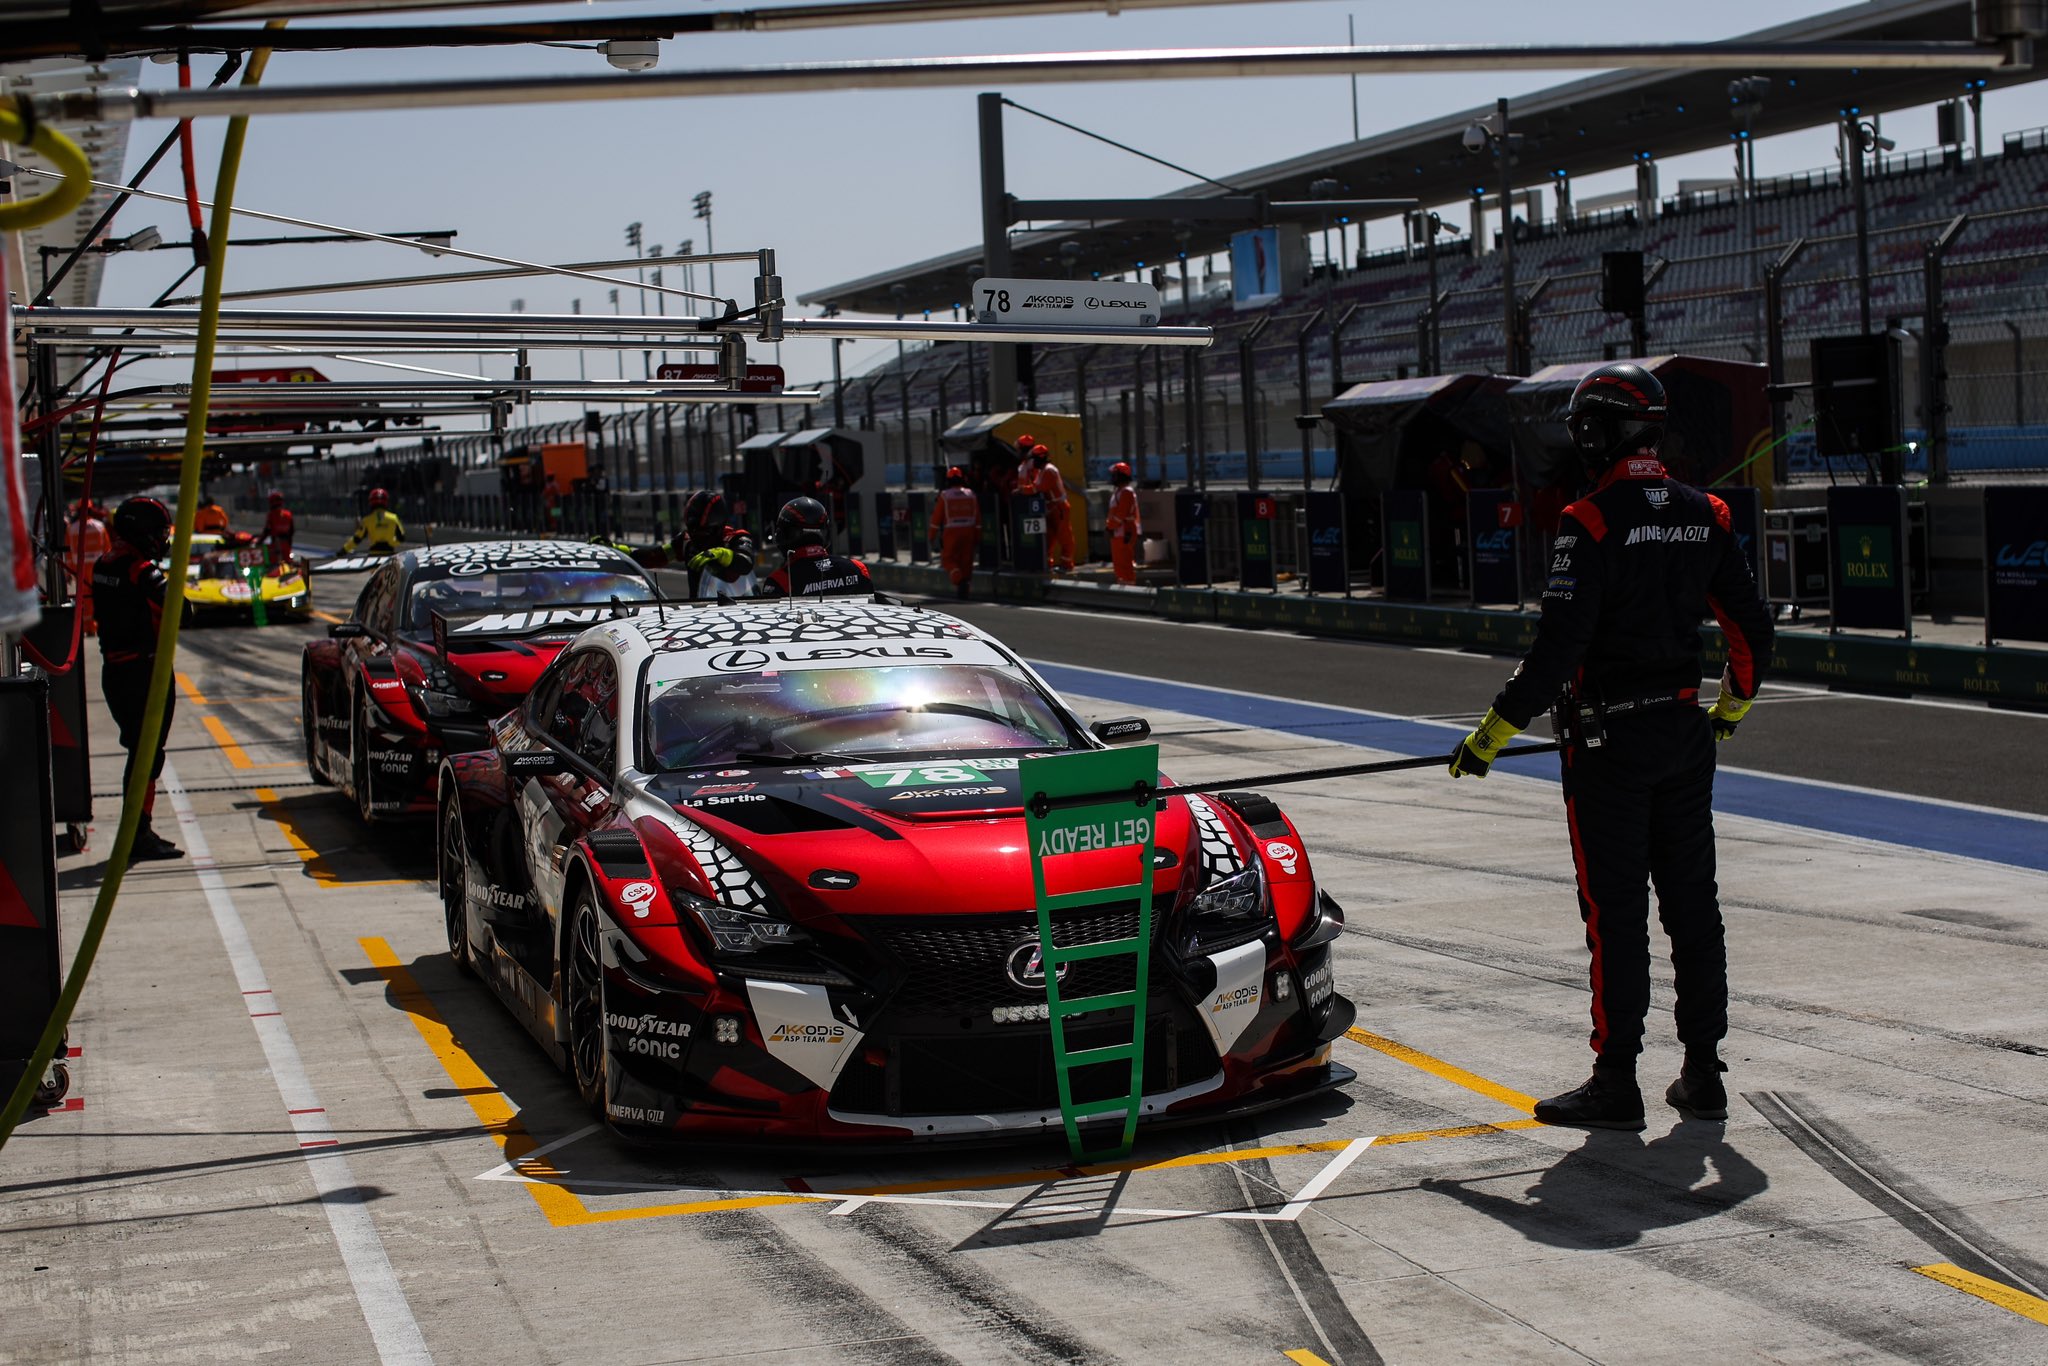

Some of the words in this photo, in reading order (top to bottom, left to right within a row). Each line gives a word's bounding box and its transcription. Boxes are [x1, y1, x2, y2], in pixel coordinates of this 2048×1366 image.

[983, 290, 1011, 313] 78
[1646, 491, 1669, 502] OMP
[1032, 501, 1040, 511] 8
[1194, 503, 1202, 516] 7
[1258, 502, 1267, 515] 8
[1502, 507, 1512, 523] 7
[1025, 520, 1041, 531] 78
[1684, 526, 1710, 542] OIL
[491, 560, 600, 570] LEXUS
[1847, 562, 1888, 578] ROLEX
[802, 578, 845, 595] MINERVA
[776, 647, 953, 661] LEXUS
[1816, 660, 1847, 676] ROLEX
[1896, 669, 1931, 686] ROLEX
[1963, 677, 2000, 693] ROLEX
[865, 767, 976, 787] 78
[707, 794, 766, 805] Sarthe
[1038, 823, 1106, 856] READY
[1111, 818, 1150, 847] GET
[467, 881, 525, 910] GOODYEAR
[628, 885, 648, 897] CSC
[1222, 1000, 1233, 1010] ASP
[1233, 999, 1248, 1007] TEAM
[604, 1012, 692, 1037] GOODYEAR
[606, 1102, 645, 1120] MINERVA
[646, 1110, 664, 1124] OIL
